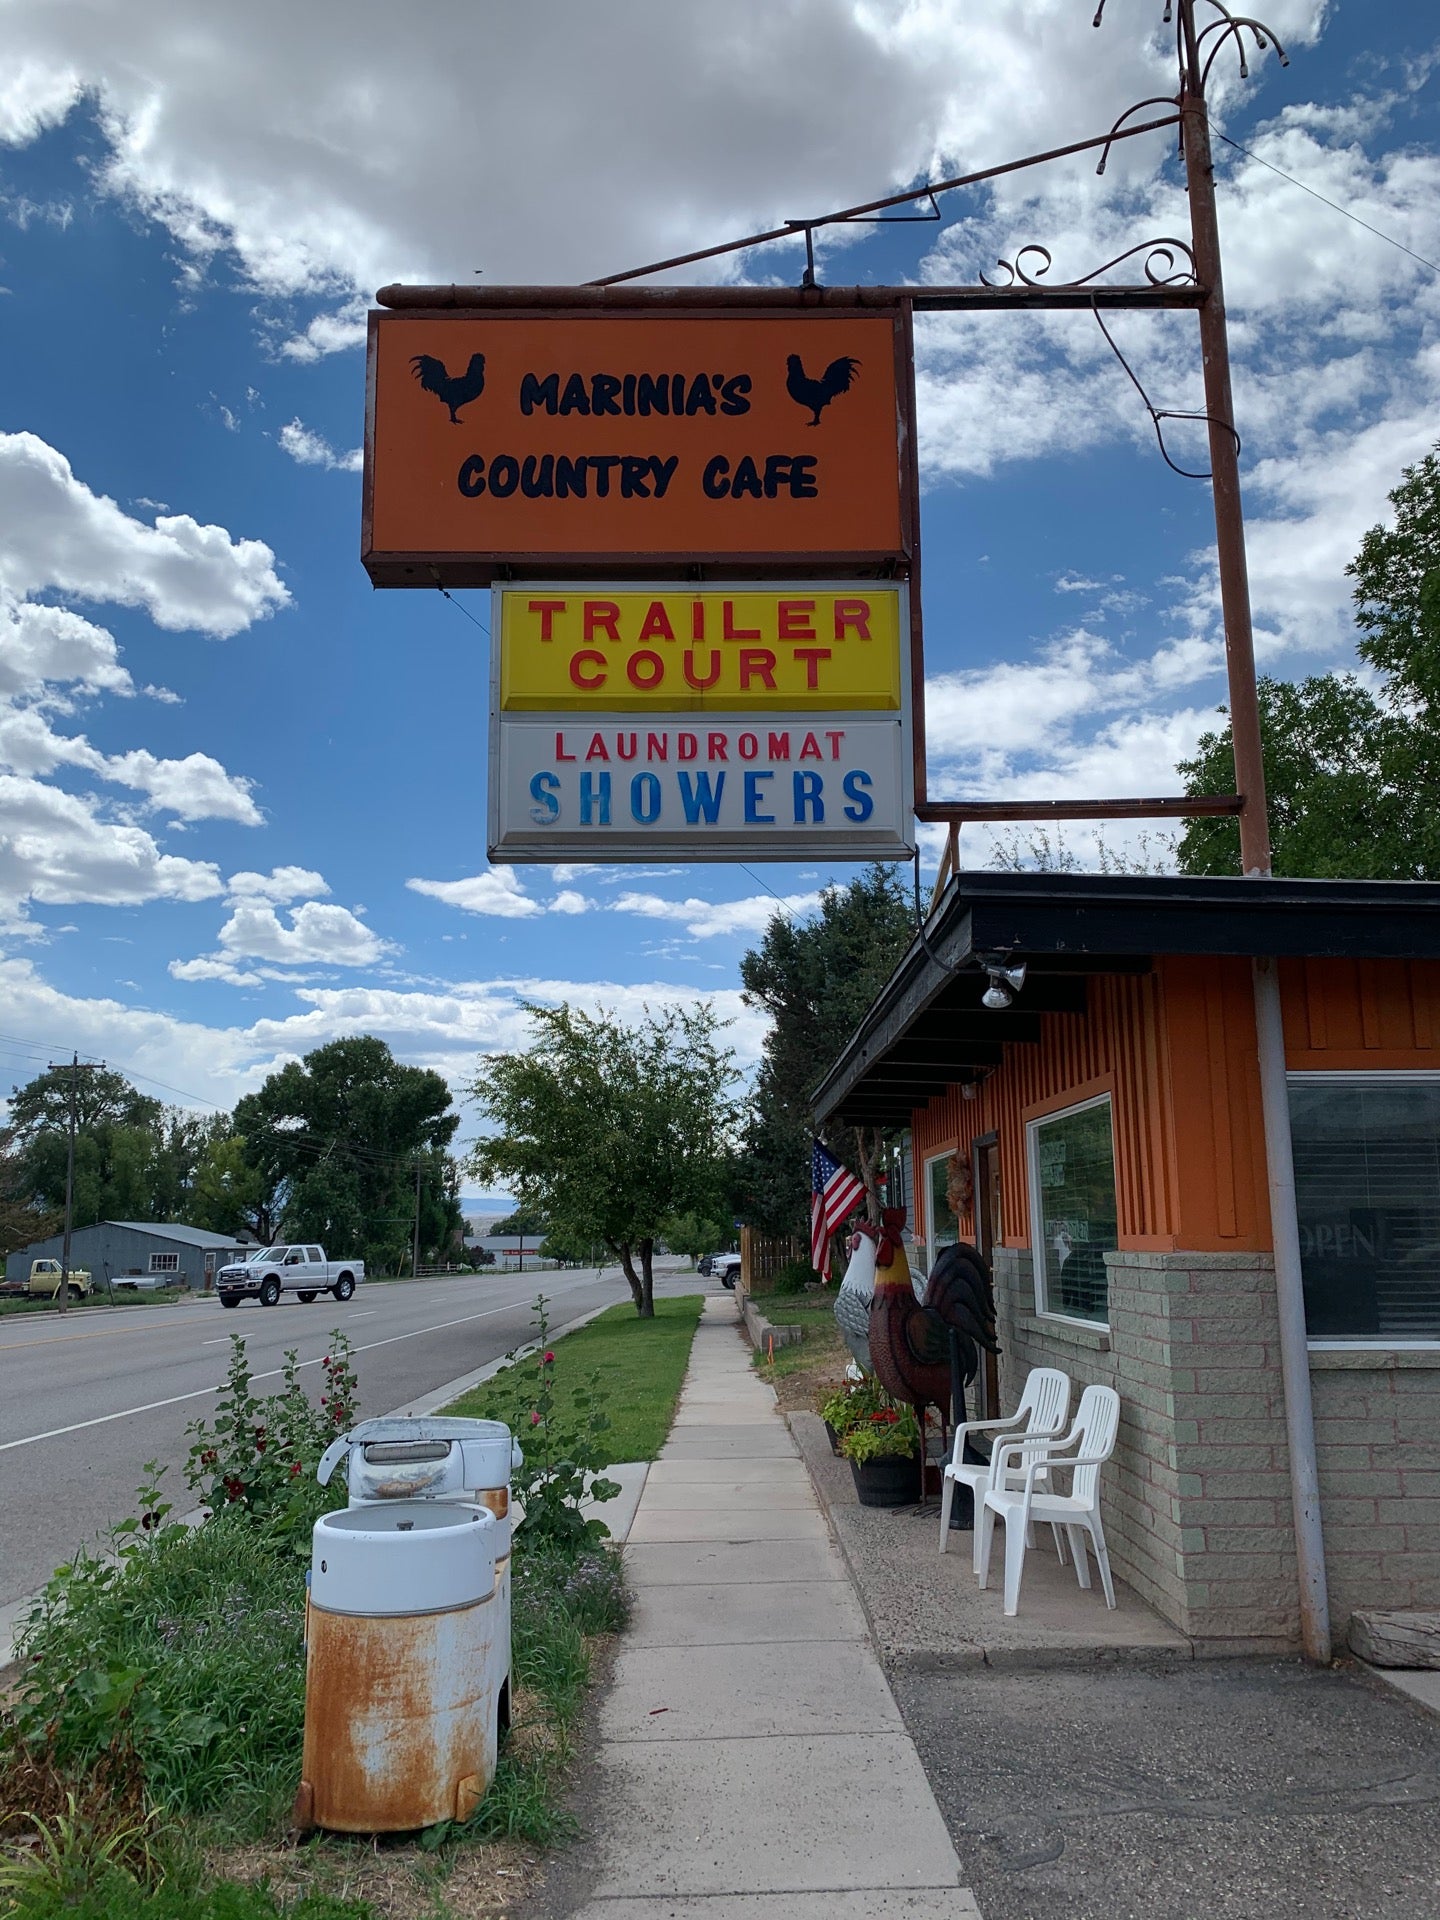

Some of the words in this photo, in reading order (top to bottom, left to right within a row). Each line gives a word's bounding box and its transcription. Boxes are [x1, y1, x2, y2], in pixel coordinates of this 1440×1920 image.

[520, 373, 752, 416] MARINIA'S
[458, 455, 679, 499] COUNTRY
[702, 455, 819, 499] CAFE
[528, 600, 872, 641] TRAILER
[569, 649, 832, 690] COURT
[556, 731, 846, 762] LAUNDROMAT
[530, 769, 874, 826] SHOWERS
